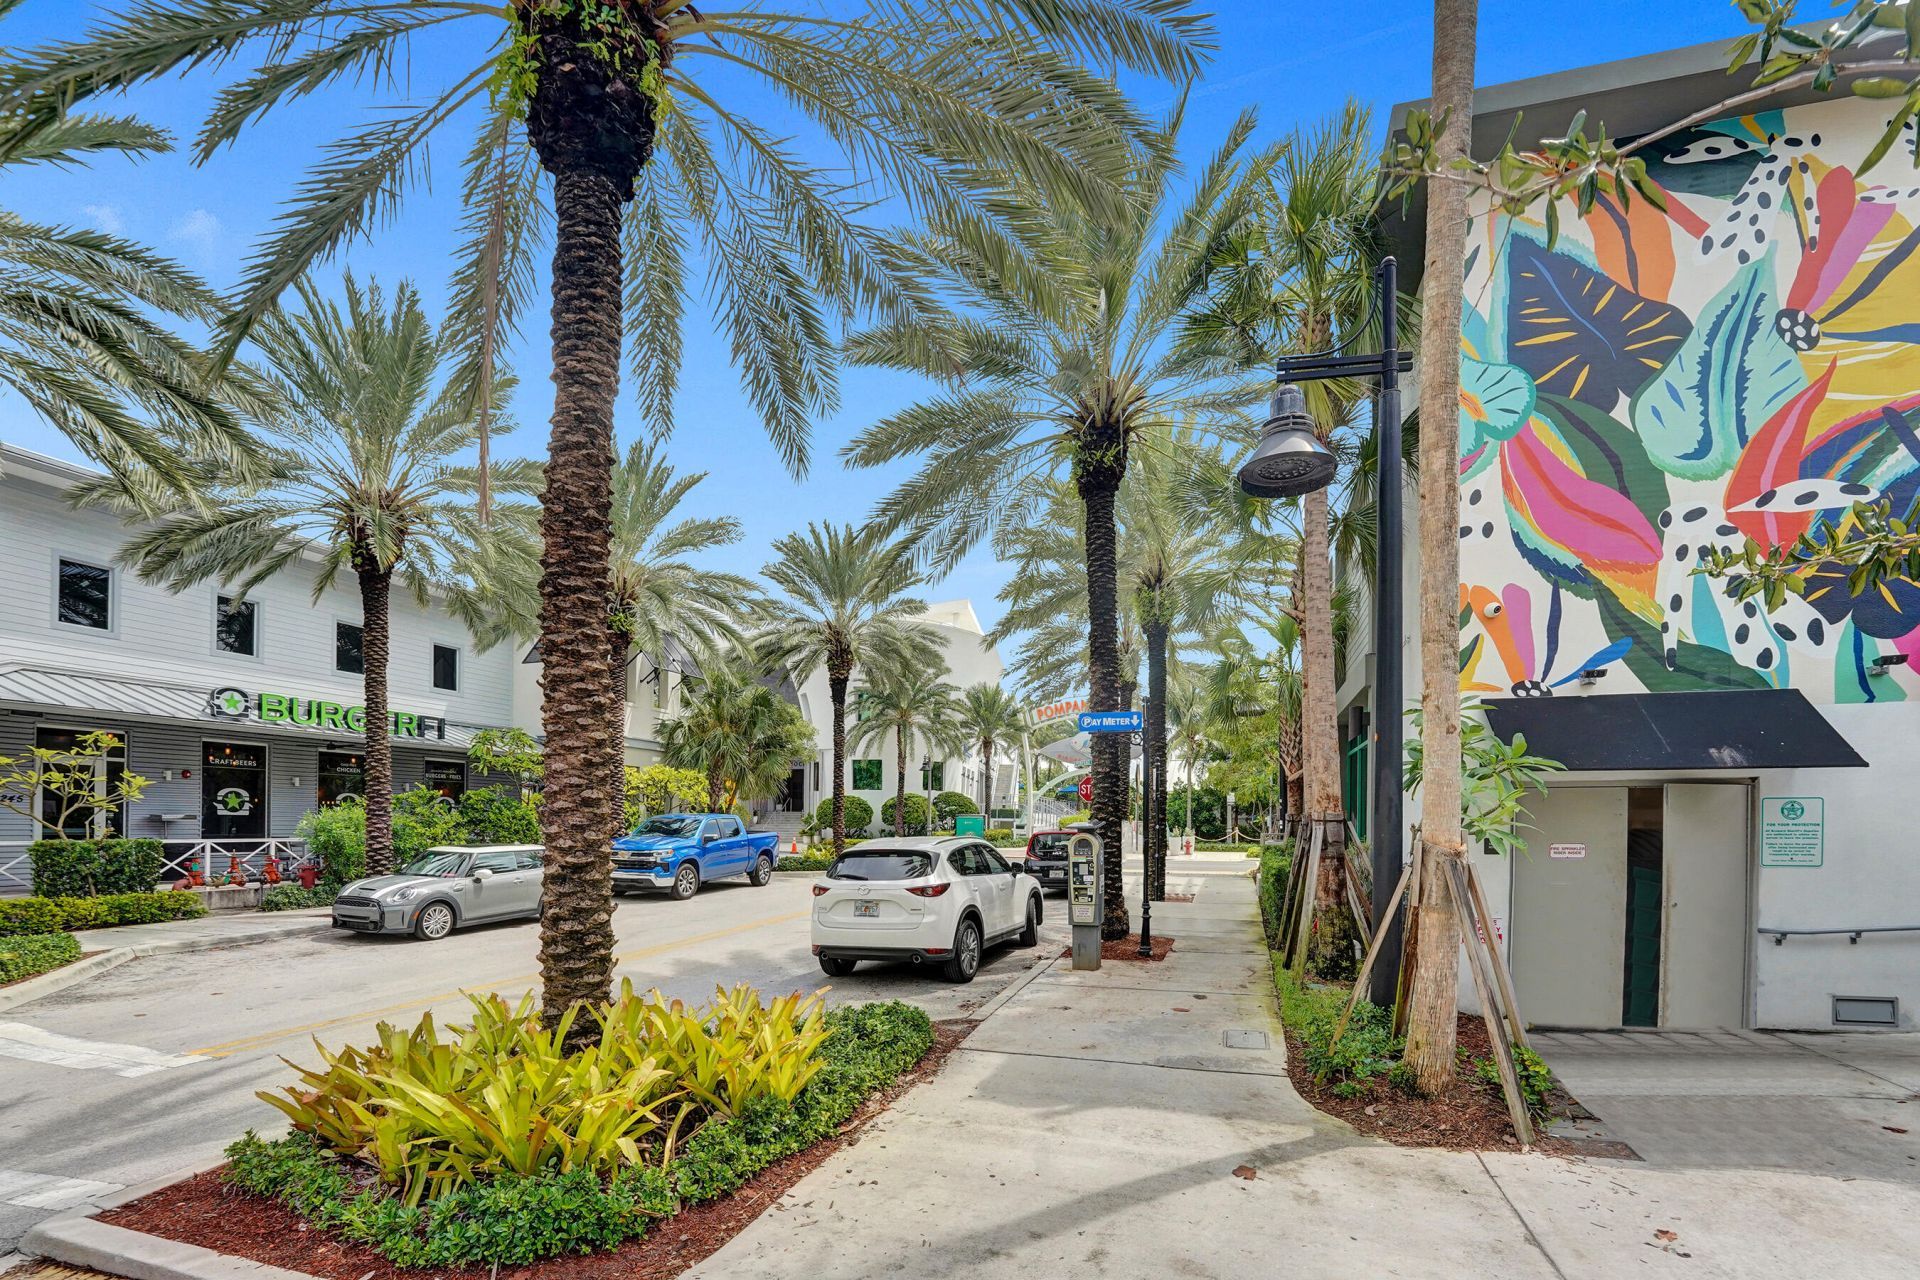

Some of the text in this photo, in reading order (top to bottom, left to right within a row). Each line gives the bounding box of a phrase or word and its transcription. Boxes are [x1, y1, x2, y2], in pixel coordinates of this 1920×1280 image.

[257, 692, 446, 740] BURGRFI
[1036, 699, 1089, 721] POMPAN
[1082, 716, 1131, 728] PAY METER
[1080, 784, 1094, 795] ST
